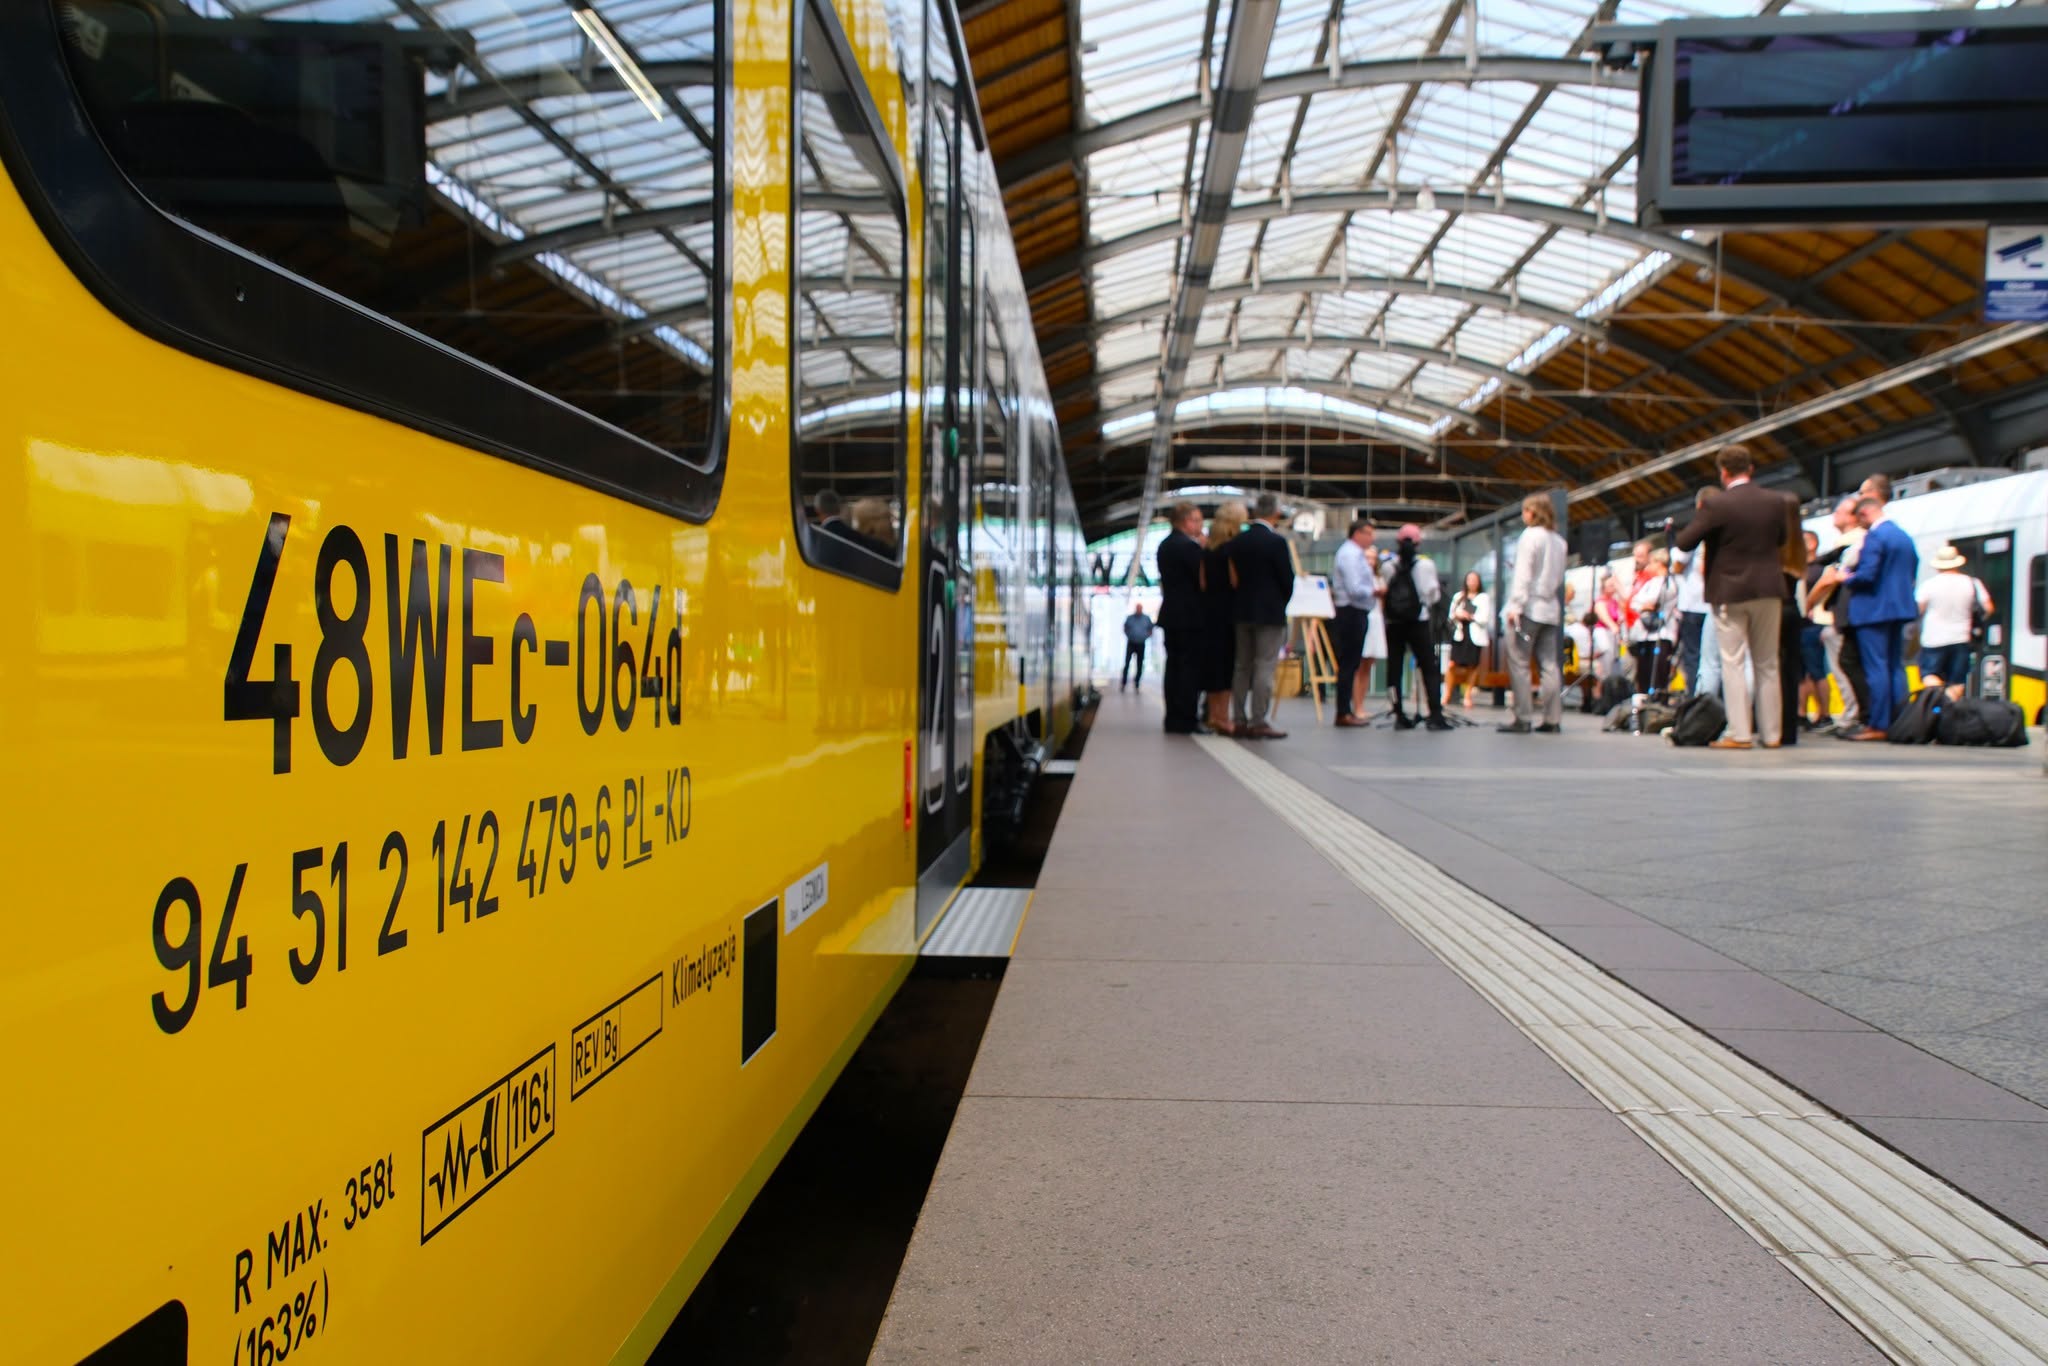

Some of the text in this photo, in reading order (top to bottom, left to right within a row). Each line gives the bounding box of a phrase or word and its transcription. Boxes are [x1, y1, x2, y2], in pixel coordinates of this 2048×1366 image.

[224, 512, 683, 775] 48WEc-064d
[930, 603, 944, 772] 2
[151, 863, 252, 1035] 94
[288, 841, 349, 985] 51
[377, 830, 408, 956] 2
[432, 810, 499, 934] 142
[516, 785, 611, 899] 479-6
[672, 924, 736, 1009] Klimatyzacja
[512, 1065, 551, 1150] 116t
[575, 1019, 618, 1082] REV Bg
[234, 1152, 395, 1315] R MAX: 358t
